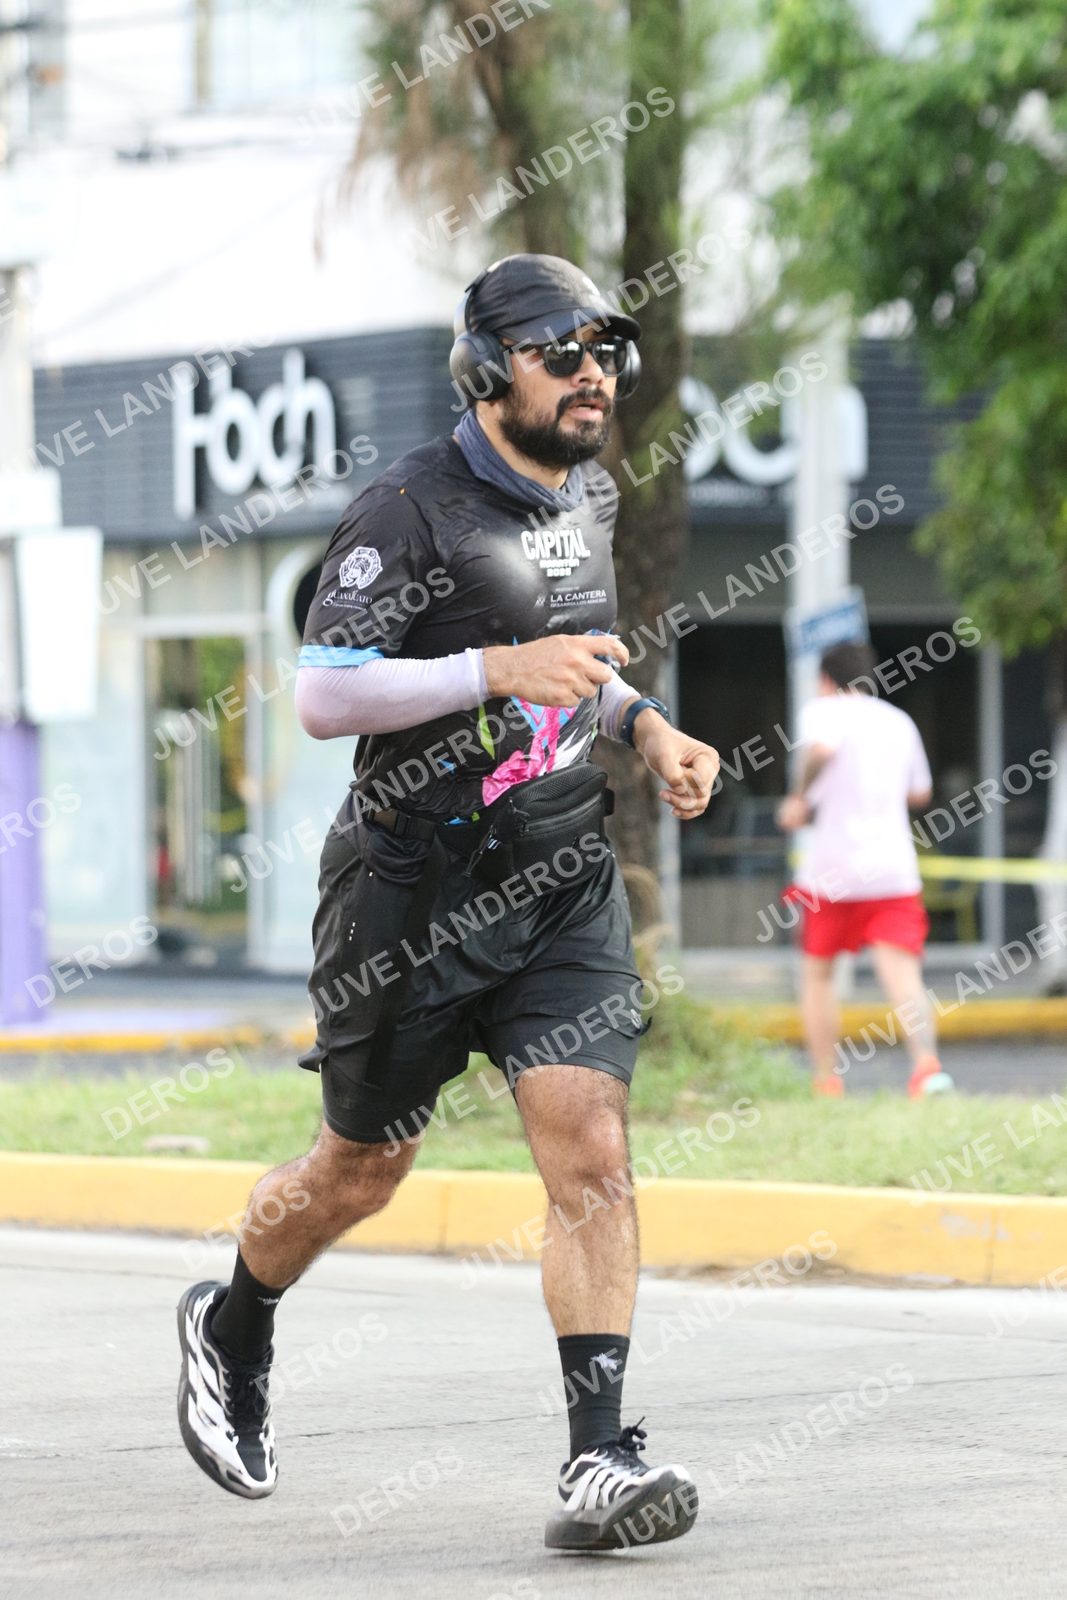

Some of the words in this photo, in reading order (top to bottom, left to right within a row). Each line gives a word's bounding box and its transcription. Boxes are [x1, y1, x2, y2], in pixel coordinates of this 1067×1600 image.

[521, 527, 591, 560] CAPITAL
[550, 594, 564, 603] LA
[565, 589, 607, 602] CANTERA
